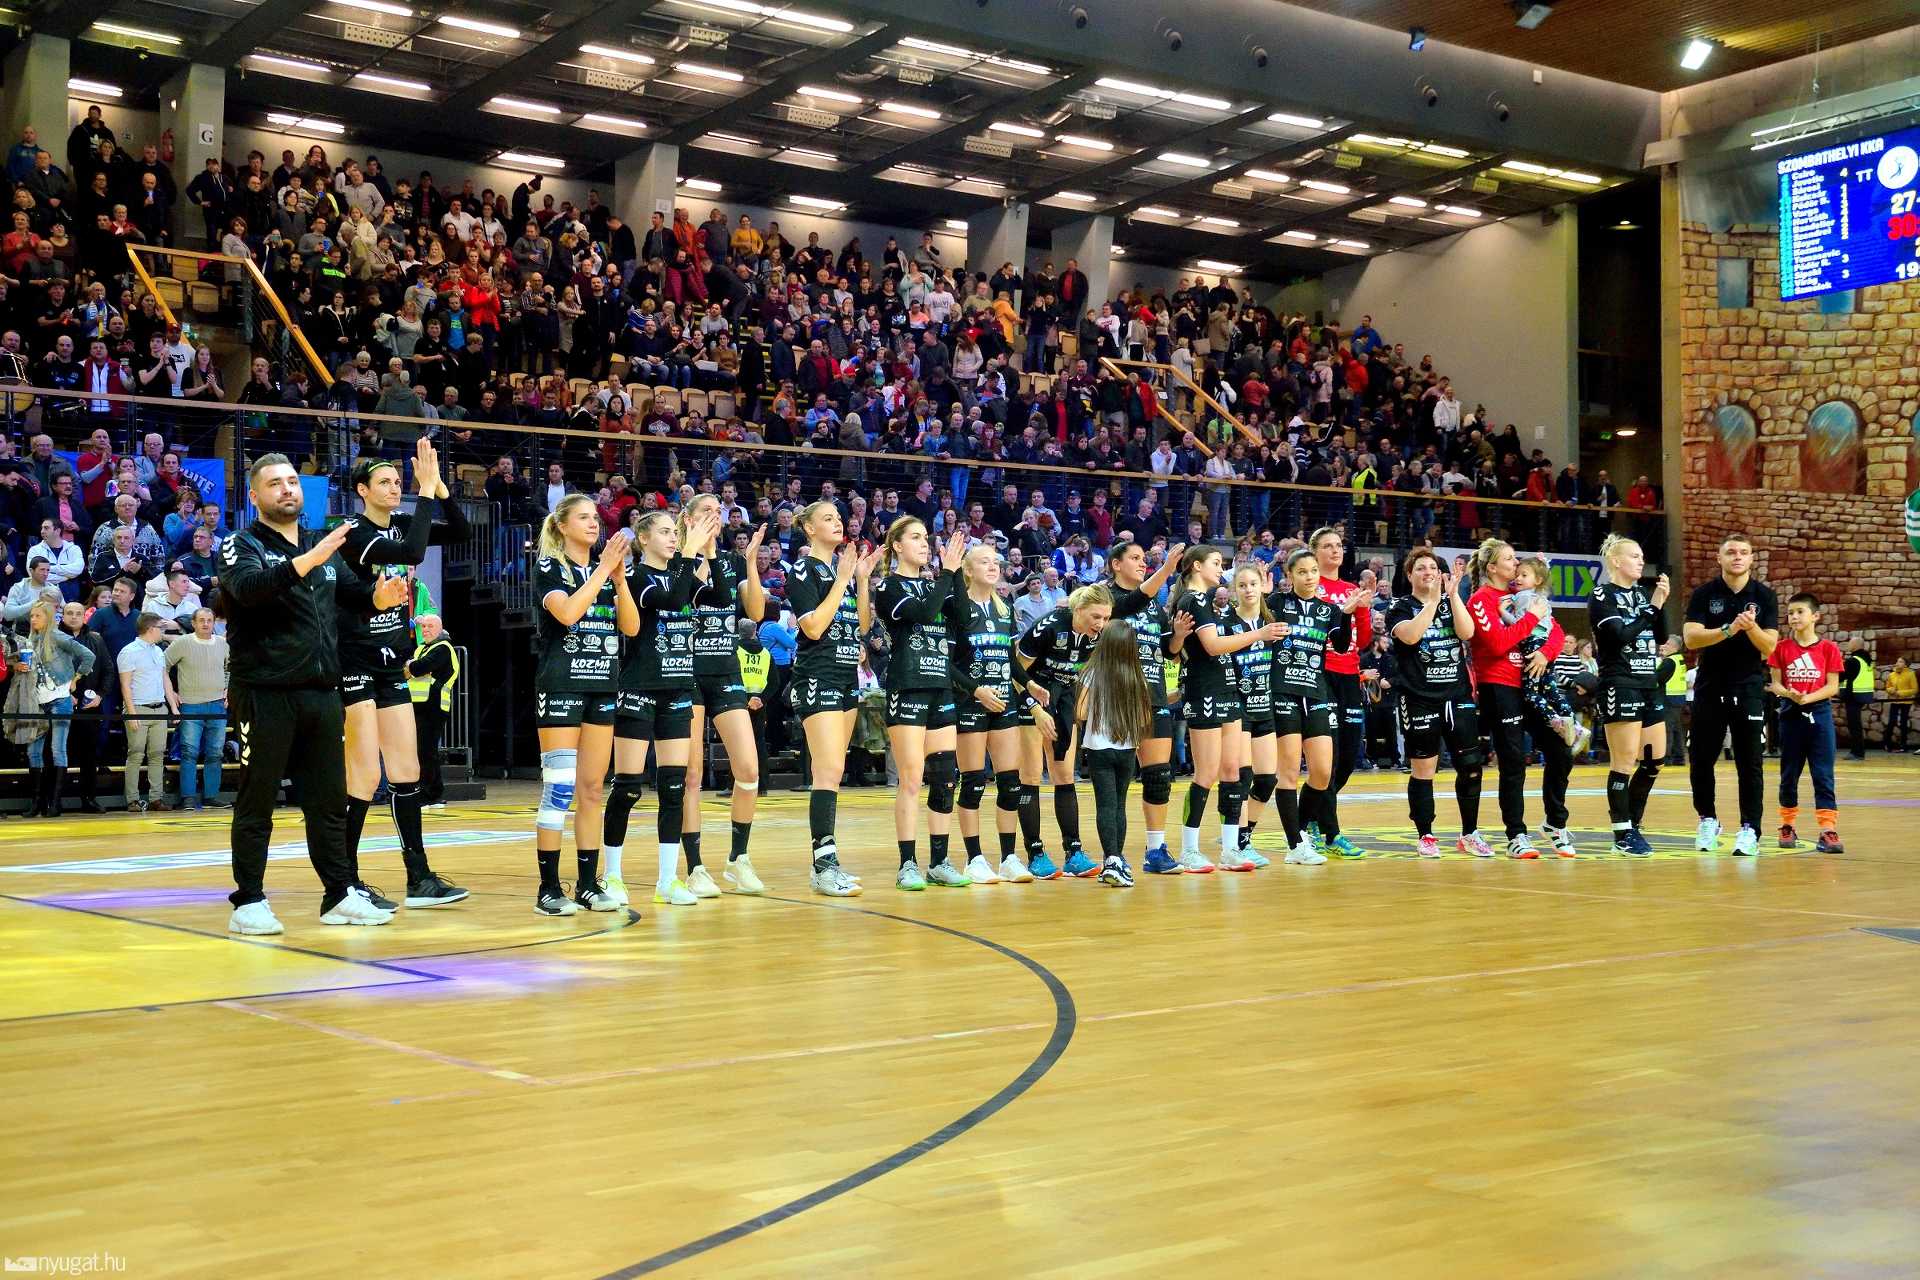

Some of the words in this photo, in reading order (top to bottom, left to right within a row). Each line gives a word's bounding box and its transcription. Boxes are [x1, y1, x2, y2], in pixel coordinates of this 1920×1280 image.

[201, 130, 212, 143] G
[1777, 143, 1859, 174] SZOMBATHELYI
[1856, 168, 1874, 183] TT
[986, 620, 995, 632] 9
[1298, 615, 1314, 626] 10
[695, 638, 732, 646] KOZMA
[570, 658, 610, 670] KOZMA
[662, 658, 692, 668] KOZMA
[1285, 667, 1316, 679] KOZMA
[1427, 666, 1458, 675] KOZMA
